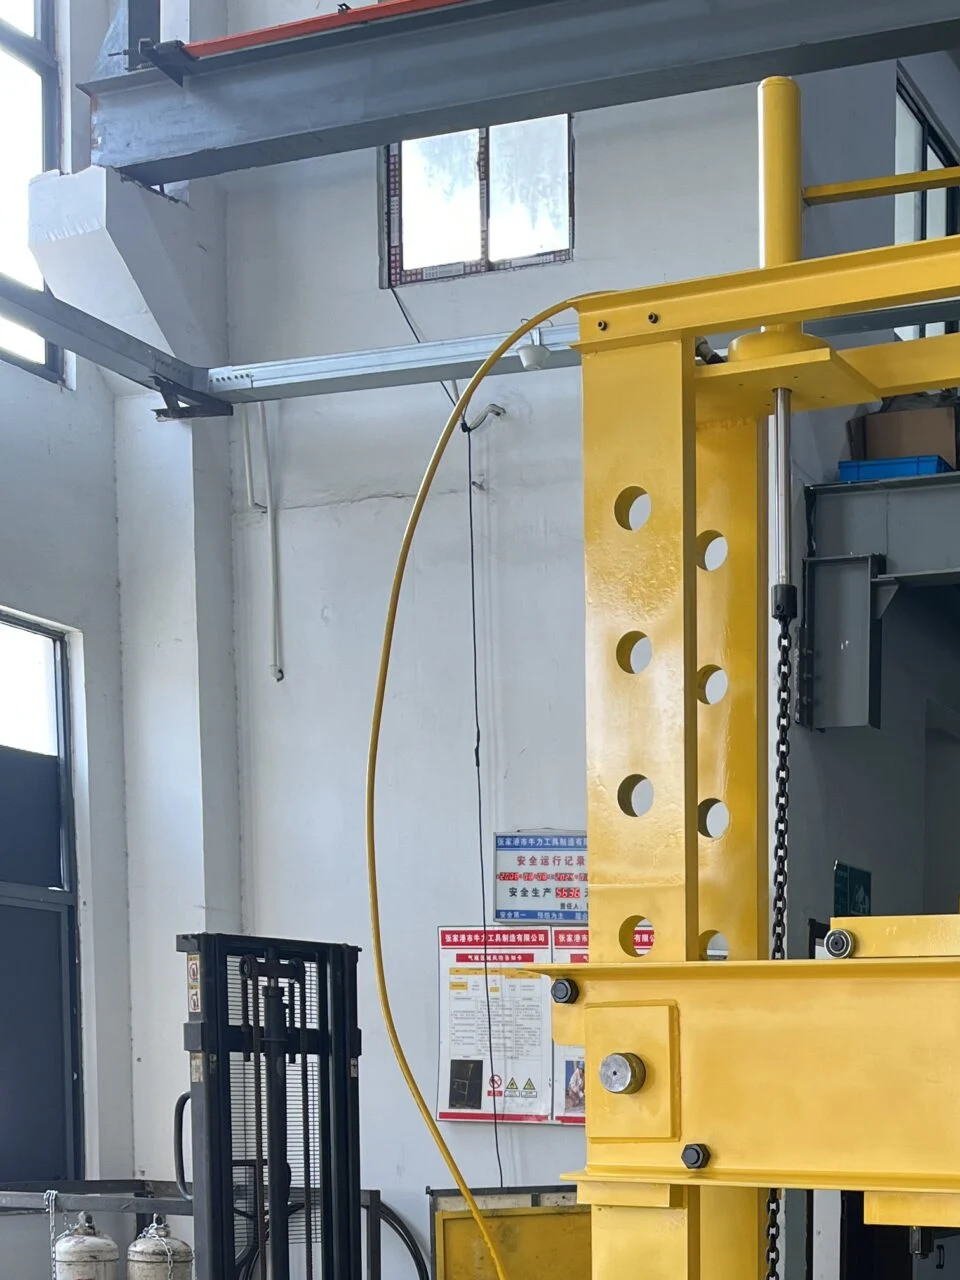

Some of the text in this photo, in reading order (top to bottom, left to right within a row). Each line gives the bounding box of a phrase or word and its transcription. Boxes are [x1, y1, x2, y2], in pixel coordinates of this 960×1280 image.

[497, 838, 587, 847] 张家港市牛力工具制造有
[517, 856, 585, 866] 安全运行记录
